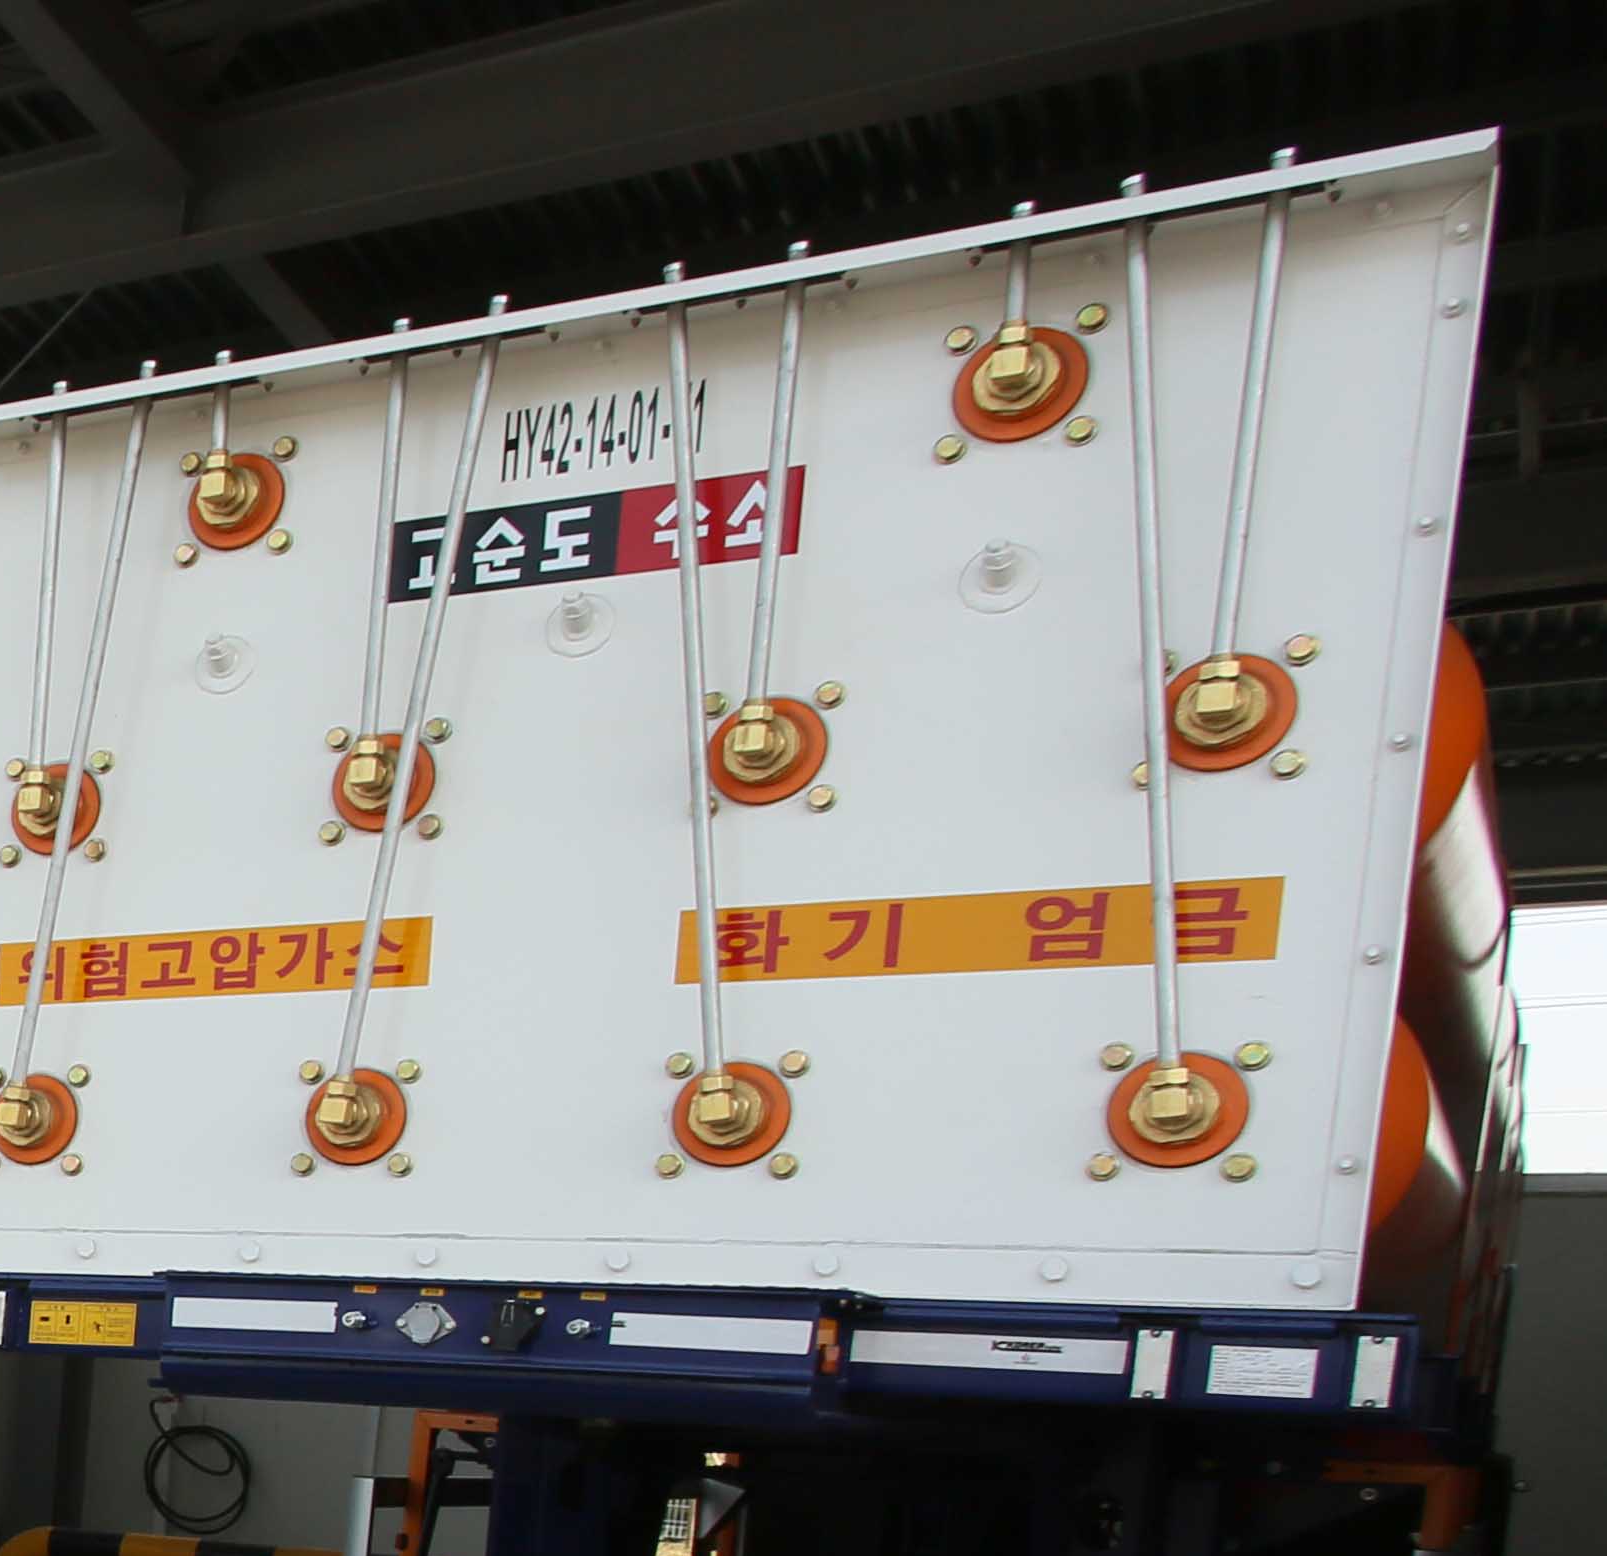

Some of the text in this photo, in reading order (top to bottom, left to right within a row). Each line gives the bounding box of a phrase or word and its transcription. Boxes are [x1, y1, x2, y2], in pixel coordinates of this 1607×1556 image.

[501, 378, 707, 483] HY42-14-01-1
[408, 479, 771, 590] 고순도 수소
[17, 927, 405, 1001] 위험고압가스
[715, 886, 1250, 974] 화기 엄금
